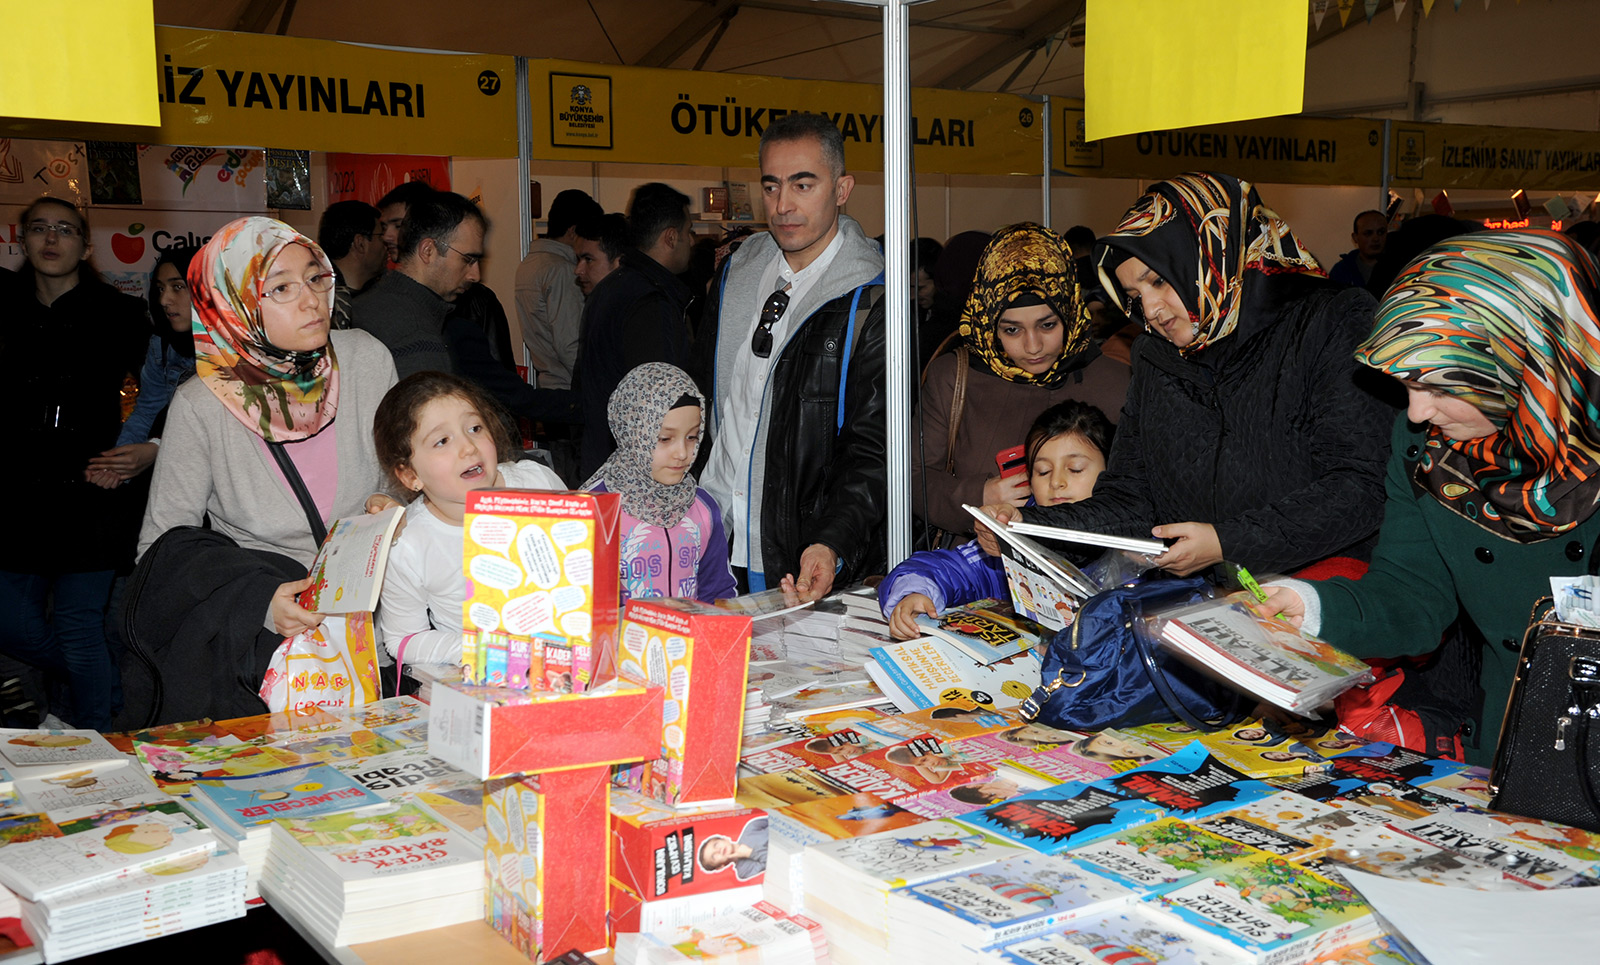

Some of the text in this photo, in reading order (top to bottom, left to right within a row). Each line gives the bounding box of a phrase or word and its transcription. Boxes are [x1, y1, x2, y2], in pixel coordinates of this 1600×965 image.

[216, 68, 425, 119] YAYINLARI
[480, 77, 499, 91] 27
[559, 111, 605, 124] BÜYÜKŞEHİR
[569, 105, 594, 114] KONYA
[1019, 112, 1033, 124] 26
[1234, 133, 1338, 164] YAYINLARI
[1441, 140, 1497, 170] İZLENİM
[1499, 147, 1542, 171] SANAT
[896, 646, 937, 689] MANTIKSAL
[920, 641, 962, 684] BECERİLERİ
[295, 674, 345, 688] NAR
[234, 787, 367, 818] BİLMECELER
[1122, 775, 1202, 811] İSMAİL
[995, 804, 1077, 838] İSMAİL
[1429, 821, 1509, 852] EDİYORUM
[350, 849, 449, 870] ÇİÇEK
[1098, 850, 1161, 874] BİTKİLER
[1176, 898, 1266, 938] ŞU ACAYİP
[1197, 894, 1271, 929] BİTKİLER
